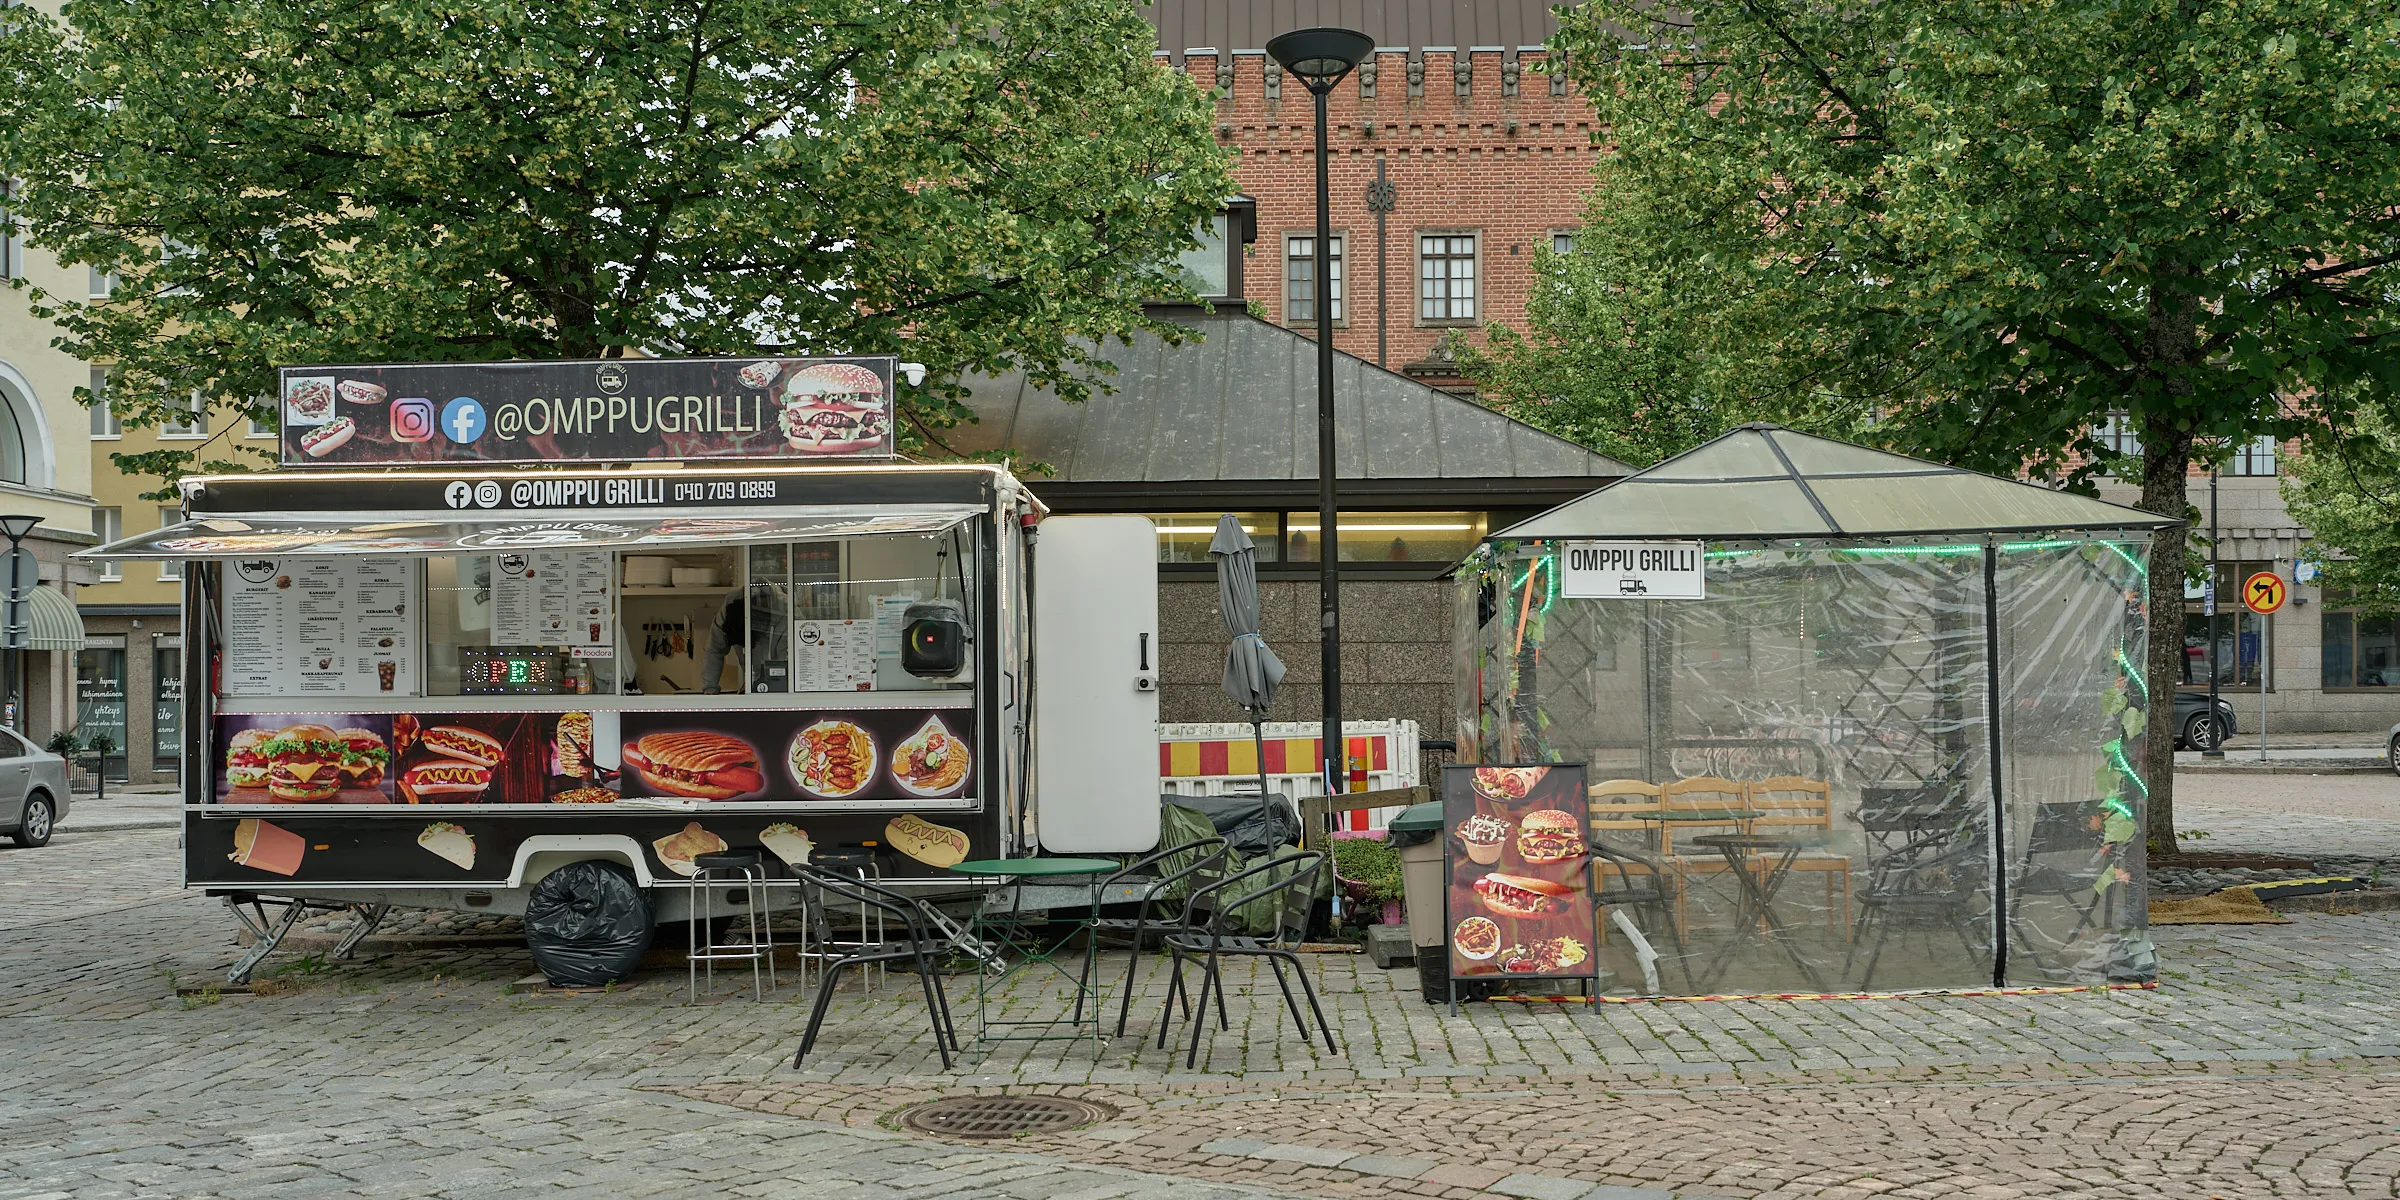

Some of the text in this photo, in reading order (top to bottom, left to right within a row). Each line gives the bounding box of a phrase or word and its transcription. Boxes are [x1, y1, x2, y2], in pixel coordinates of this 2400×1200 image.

[494, 395, 762, 441] @OMPPUGRILLI
[510, 478, 776, 508] @OMPPU GRILLI 040 709 0899
[1571, 549, 1695, 571] OMPPU GRILLI
[583, 649, 612, 657] foodora
[471, 660, 547, 683] OPEN
[99, 677, 118, 688] hymy
[161, 691, 182, 702] olkap
[95, 705, 120, 718] yhteys
[158, 708, 173, 720] ilo
[159, 741, 180, 750] toivo
